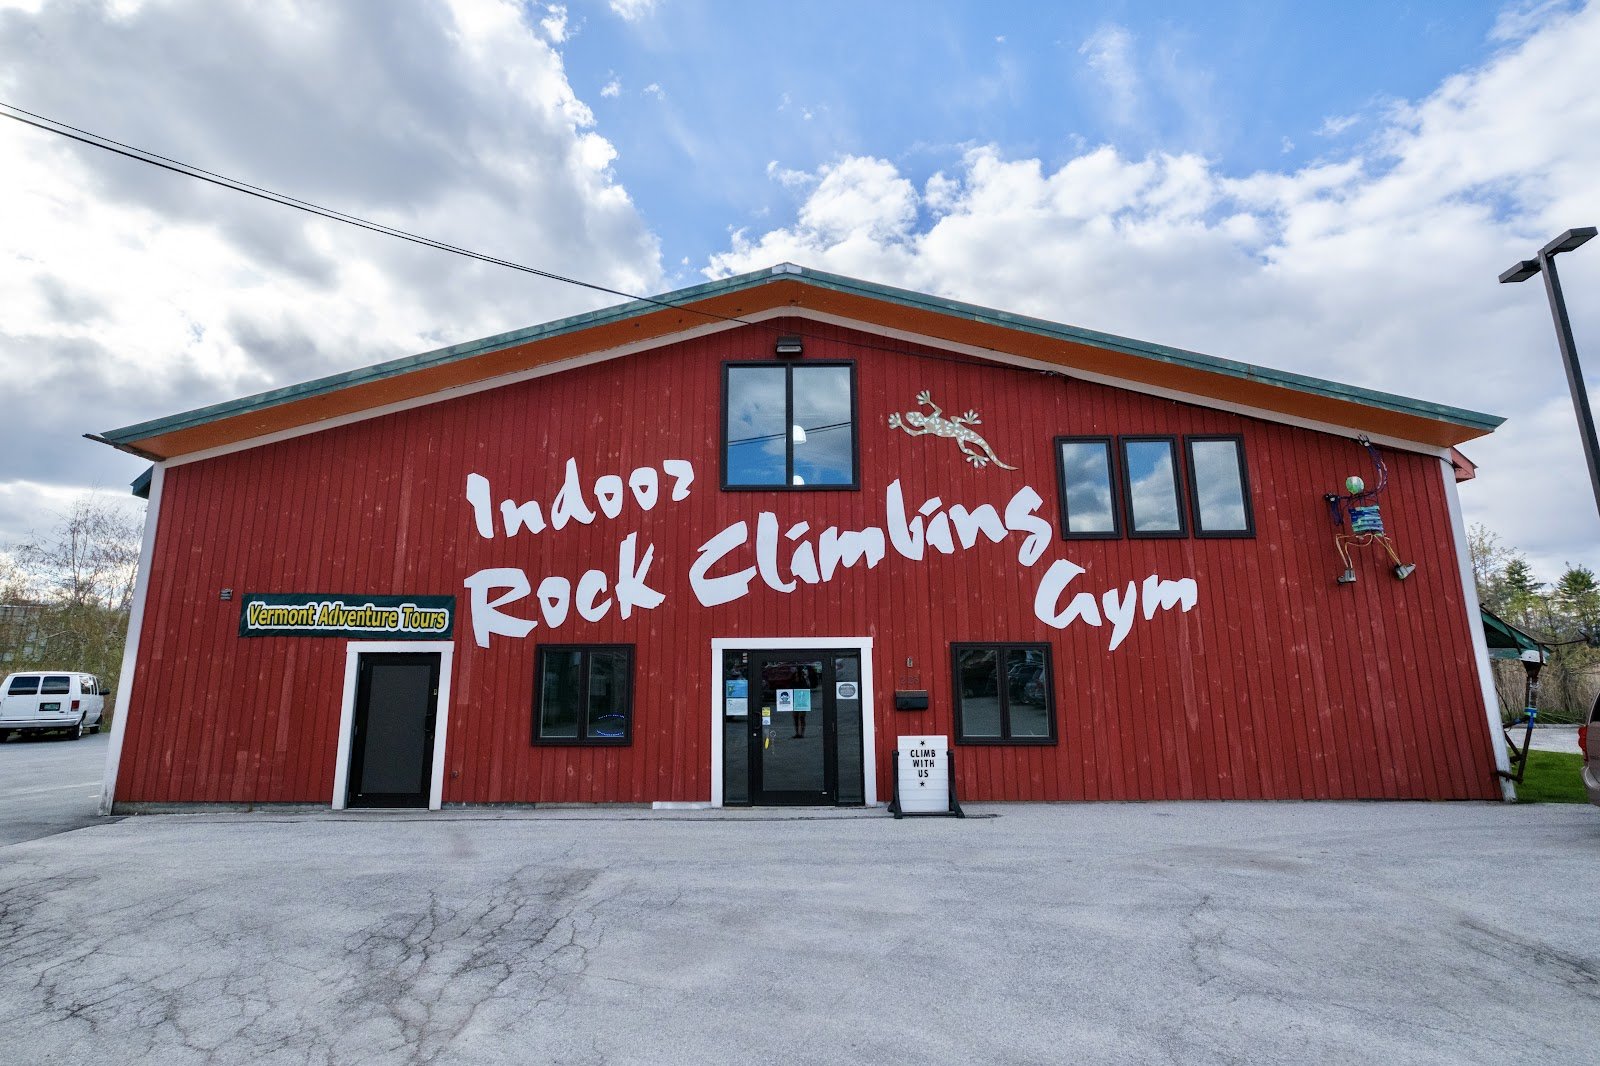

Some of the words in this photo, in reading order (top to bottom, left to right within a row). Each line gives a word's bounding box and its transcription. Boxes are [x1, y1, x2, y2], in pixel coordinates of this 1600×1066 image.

[466, 456, 695, 541] Indoor
[463, 531, 666, 649] Rock
[688, 478, 1053, 608] Climbing
[249, 603, 316, 627] Vermont
[317, 604, 399, 628] Adventure
[402, 606, 446, 629] Tours
[1034, 558, 1198, 652] Gym
[910, 749, 936, 758] CLIMB
[912, 759, 935, 768] WITH
[918, 769, 929, 778] US
